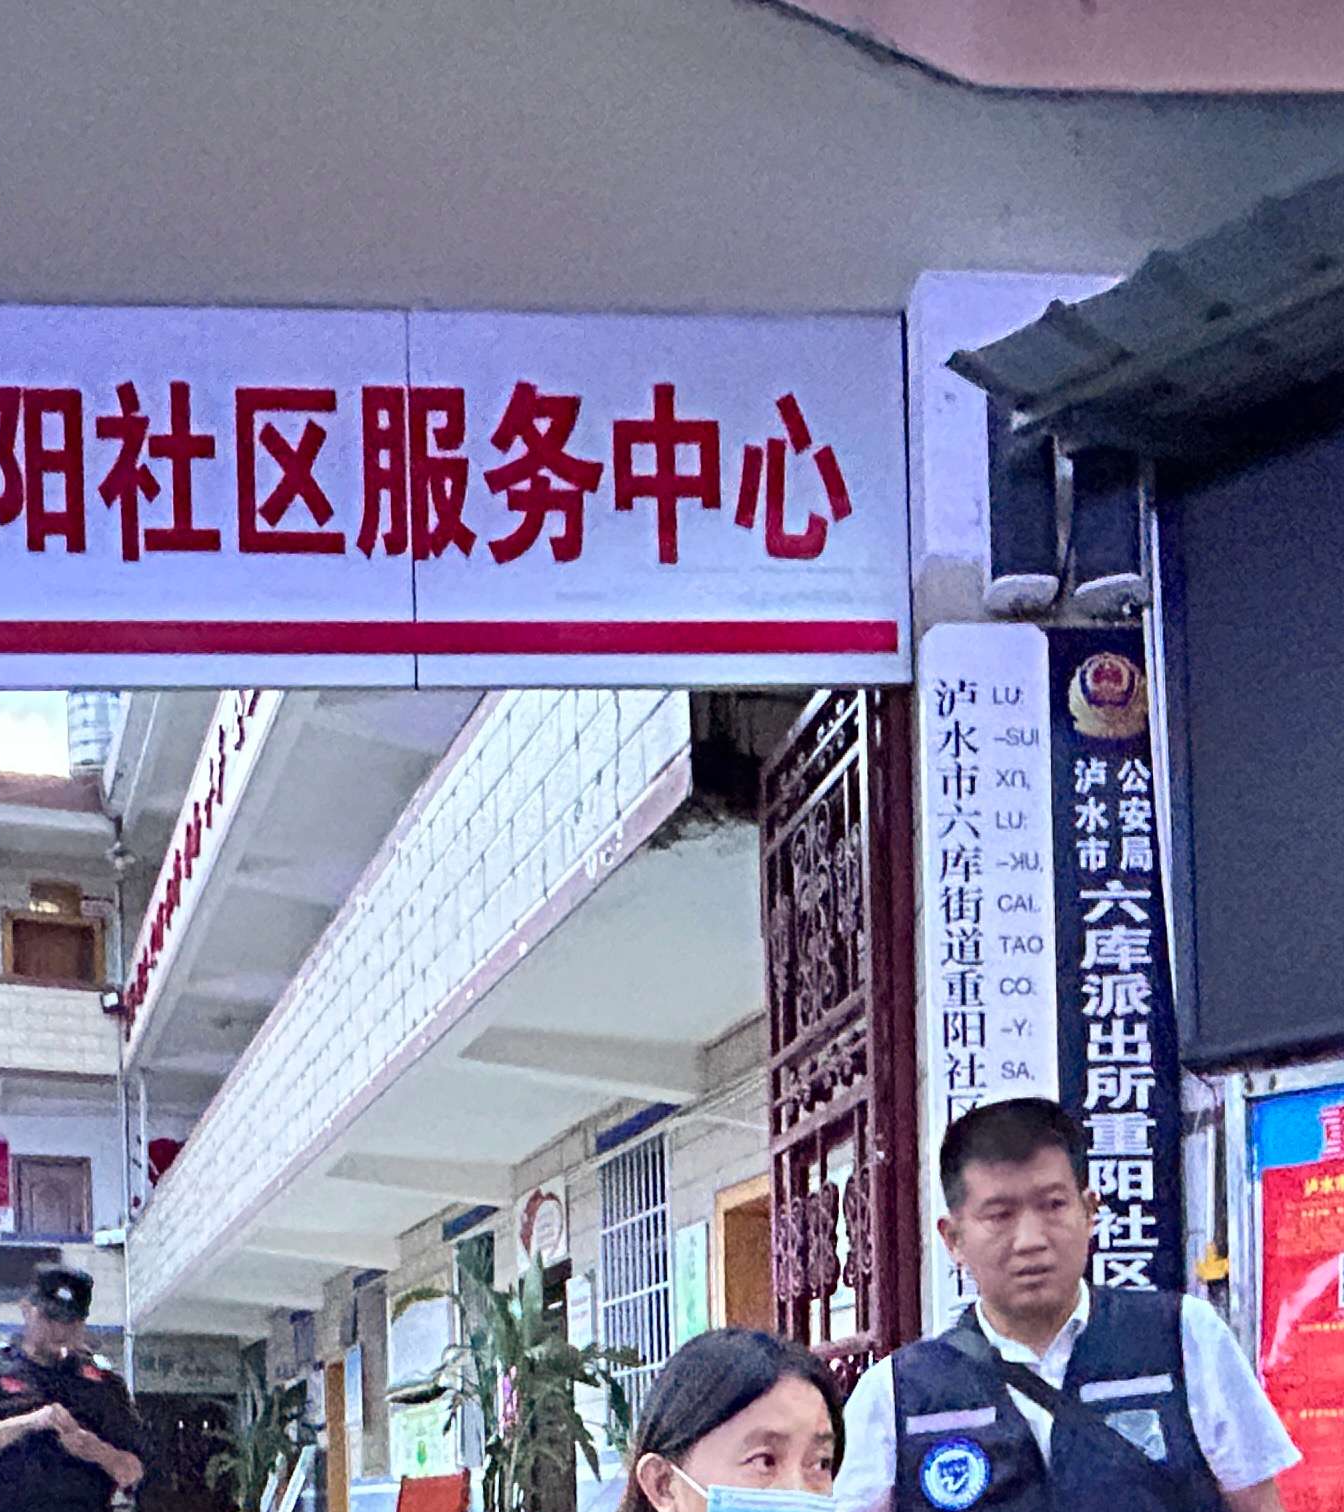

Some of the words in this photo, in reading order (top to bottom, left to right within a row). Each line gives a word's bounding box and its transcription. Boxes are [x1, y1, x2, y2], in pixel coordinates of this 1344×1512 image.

[1075, 757, 1109, 876] 泸水市
[1117, 757, 1153, 874] 公安局
[1081, 880, 1159, 1292] 六库派出所重阳社区
